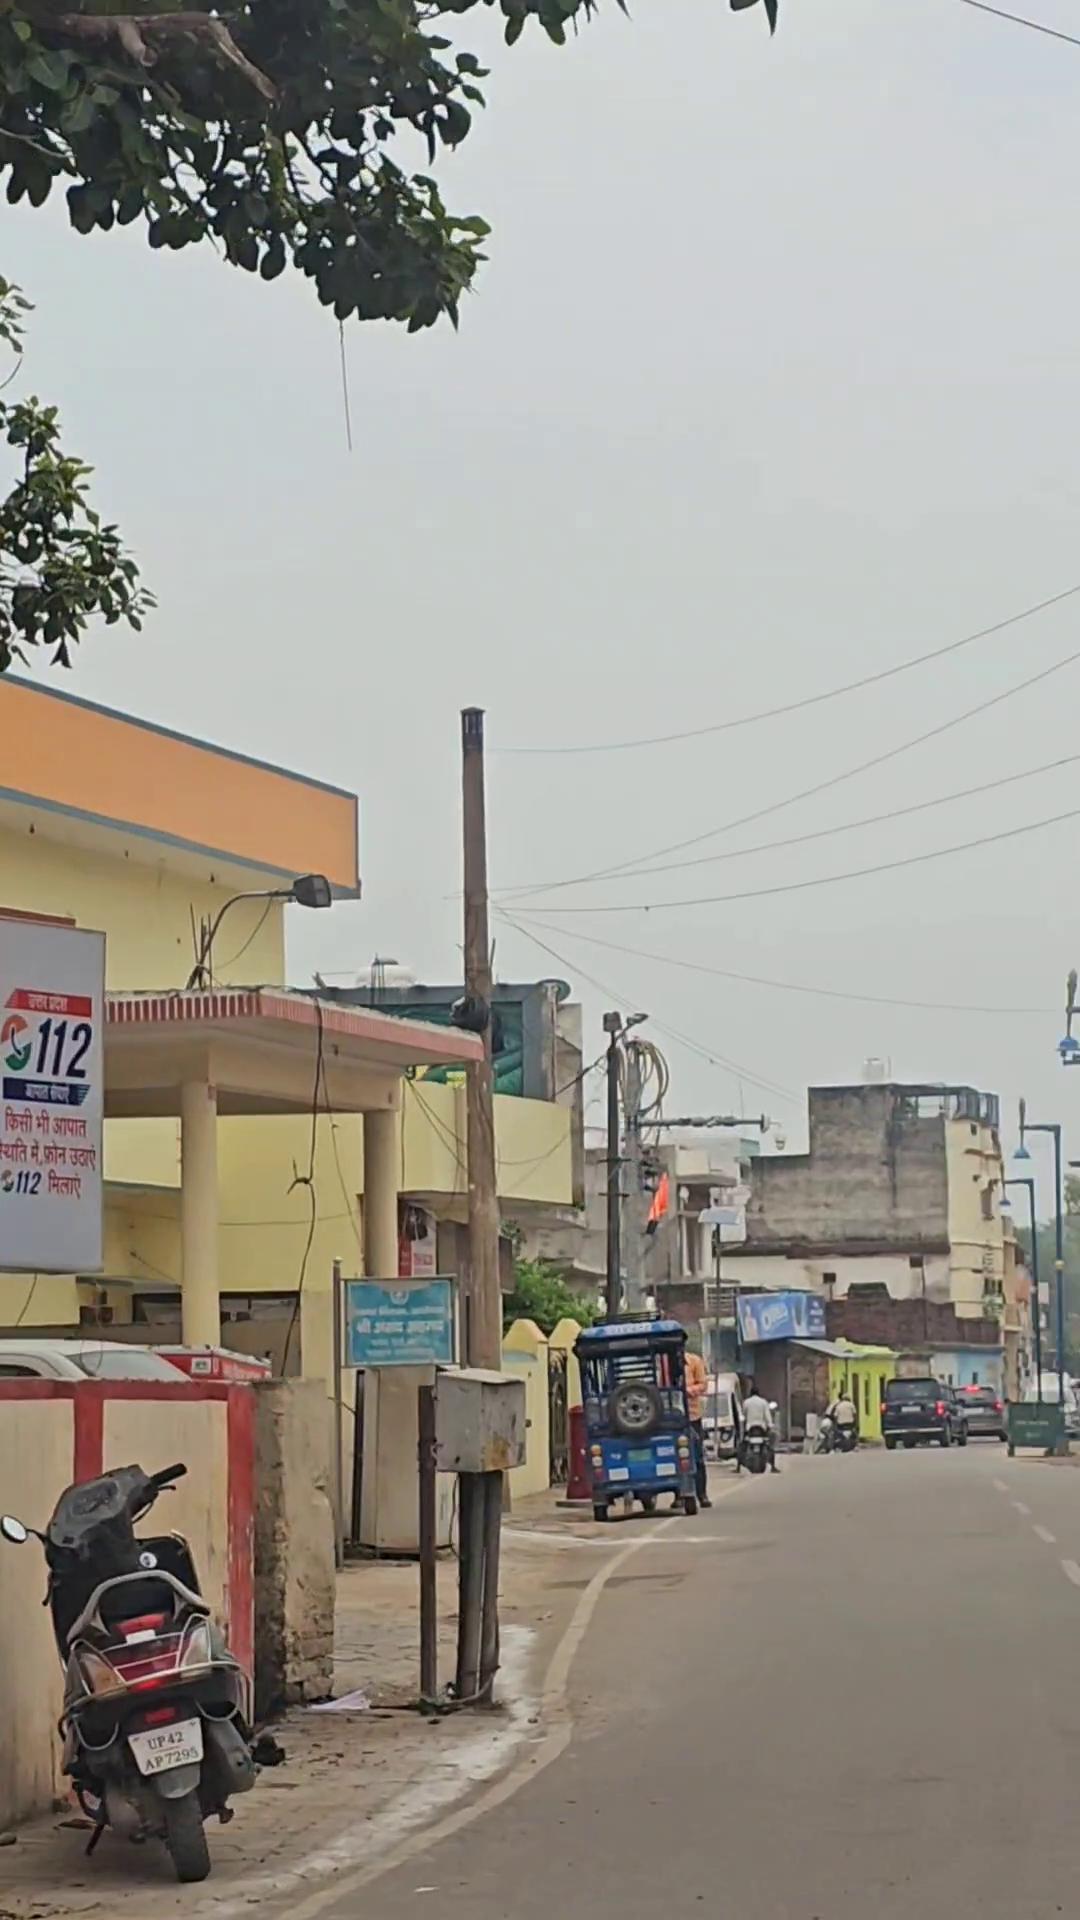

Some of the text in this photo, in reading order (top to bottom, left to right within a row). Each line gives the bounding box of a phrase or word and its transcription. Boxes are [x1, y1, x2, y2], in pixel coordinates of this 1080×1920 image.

[36, 1017, 92, 1078] 112
[5, 1106, 87, 1138] किसी भी आपात
[16, 1169, 81, 1199] 112 मिलाएं
